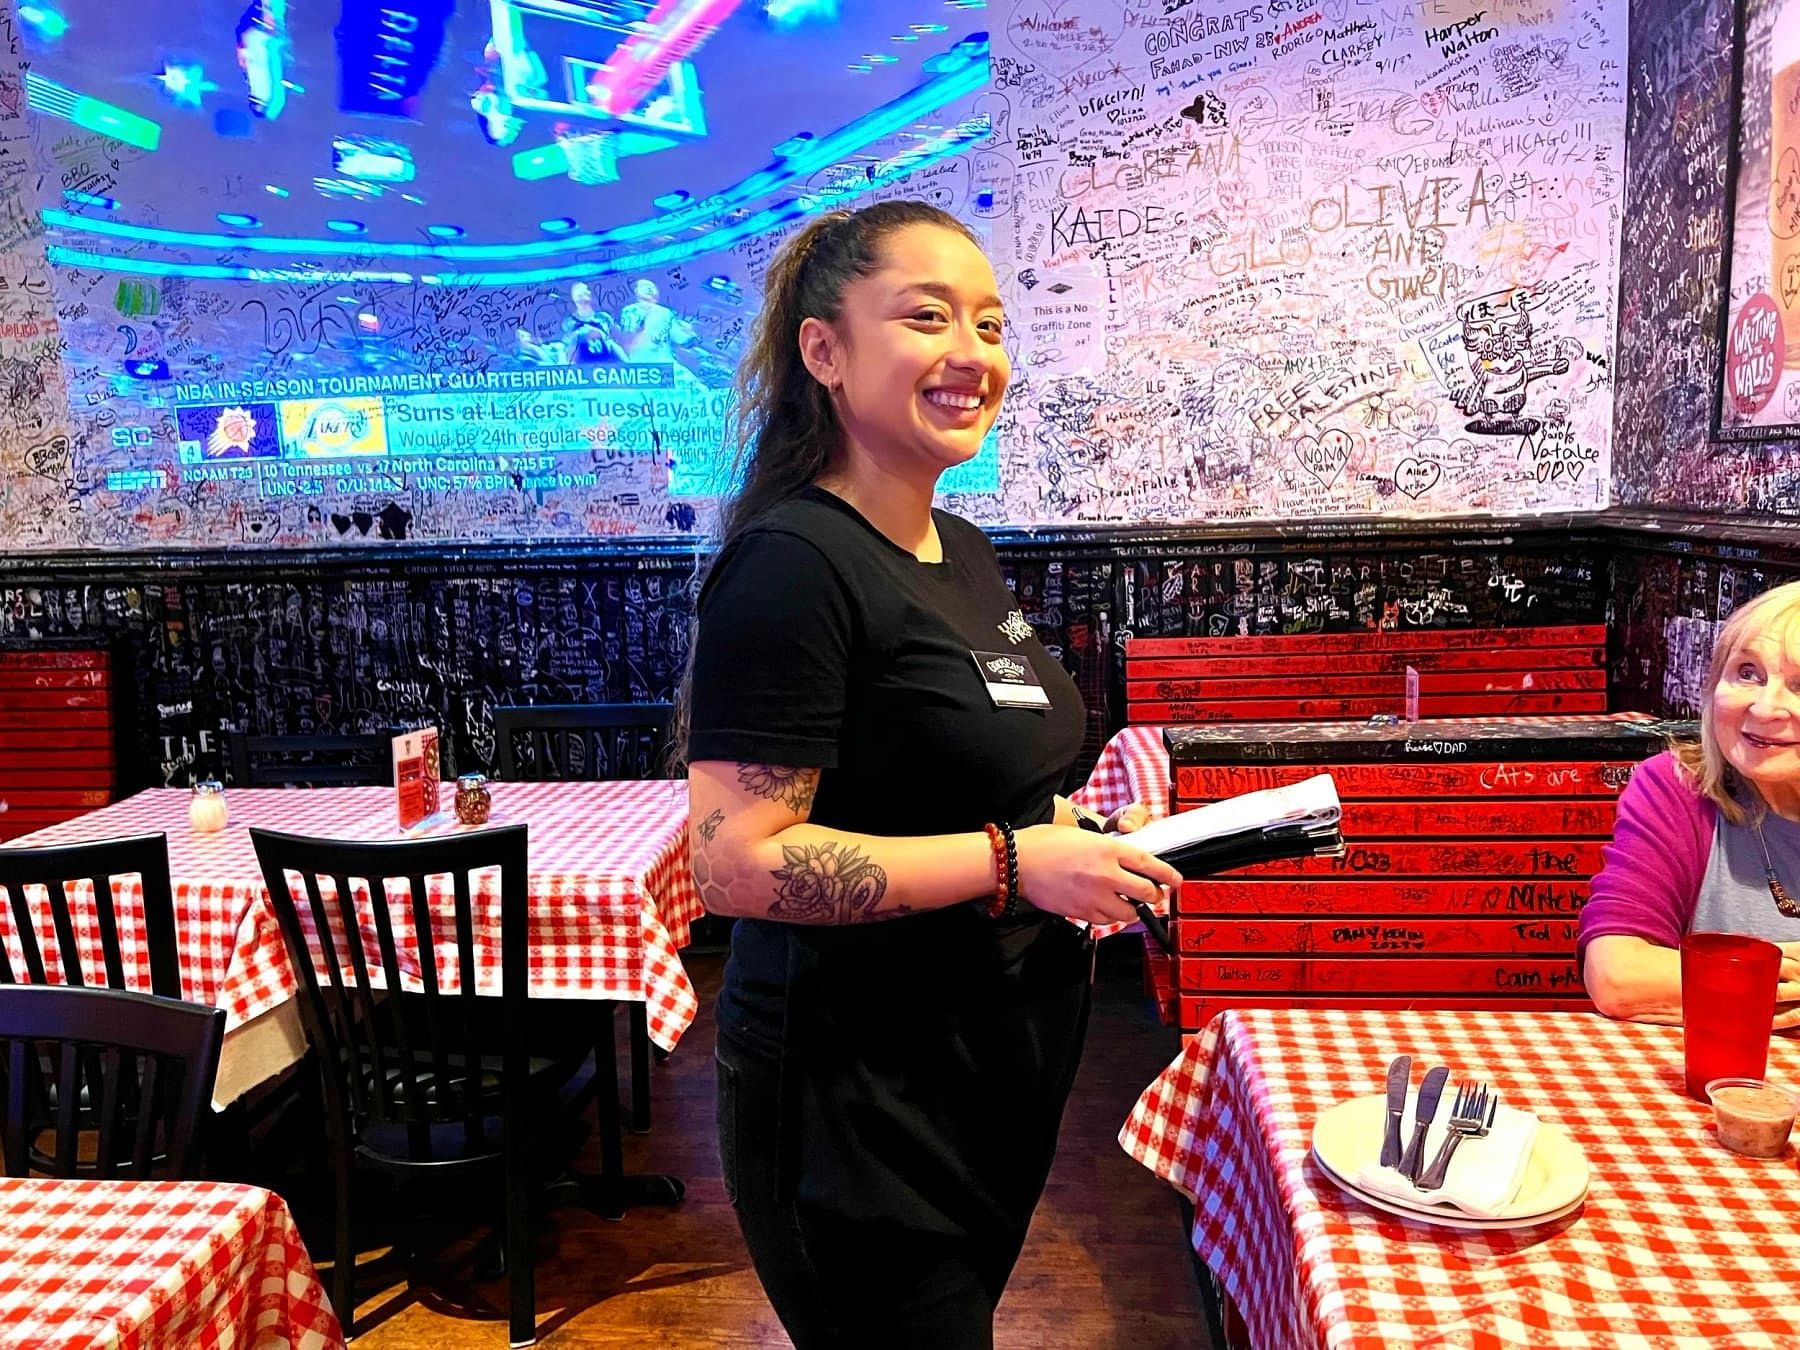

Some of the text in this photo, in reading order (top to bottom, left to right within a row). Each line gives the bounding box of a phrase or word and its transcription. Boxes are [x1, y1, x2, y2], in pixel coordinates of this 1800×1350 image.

[1145, 7, 1263, 55] CONGRATS
[1284, 11, 1323, 40] ANDREA
[1425, 10, 1487, 48] Harper
[1271, 28, 1324, 60] RODRIGO
[1321, 34, 1384, 65] CLARKEY
[1441, 27, 1499, 59] Walton
[1309, 167, 1491, 233] OLIVIA
[1034, 306, 1053, 316] This
[1055, 305, 1063, 314] is
[1074, 303, 1088, 314] No
[1031, 319, 1092, 332] Graffiti Zone
[1734, 307, 1777, 356] WRITING
[1283, 356, 1307, 376] AMY
[1734, 352, 1775, 397] WALLS
[176, 367, 662, 401] NBA IN-SEASON TOURNAMENT QUARTERFINAL GAMES
[398, 403, 455, 423] Suns
[462, 403, 484, 421] at
[490, 400, 575, 420] Lakers:
[1249, 380, 1311, 431] FREE
[399, 428, 451, 448] Would
[456, 429, 476, 446] be
[481, 427, 517, 446] 24th
[522, 426, 648, 449] regular-season
[107, 470, 167, 491] ESPN
[183, 468, 228, 482] NCAAM
[279, 462, 353, 477] Tennessee
[392, 458, 433, 473] North
[436, 456, 496, 472] Carolina
[539, 456, 556, 470] ET
[452, 474, 483, 490] 57%
[558, 472, 573, 486] to
[574, 472, 597, 486] win
[1443, 741, 1467, 753] DAD
[1547, 769, 1582, 787] are
